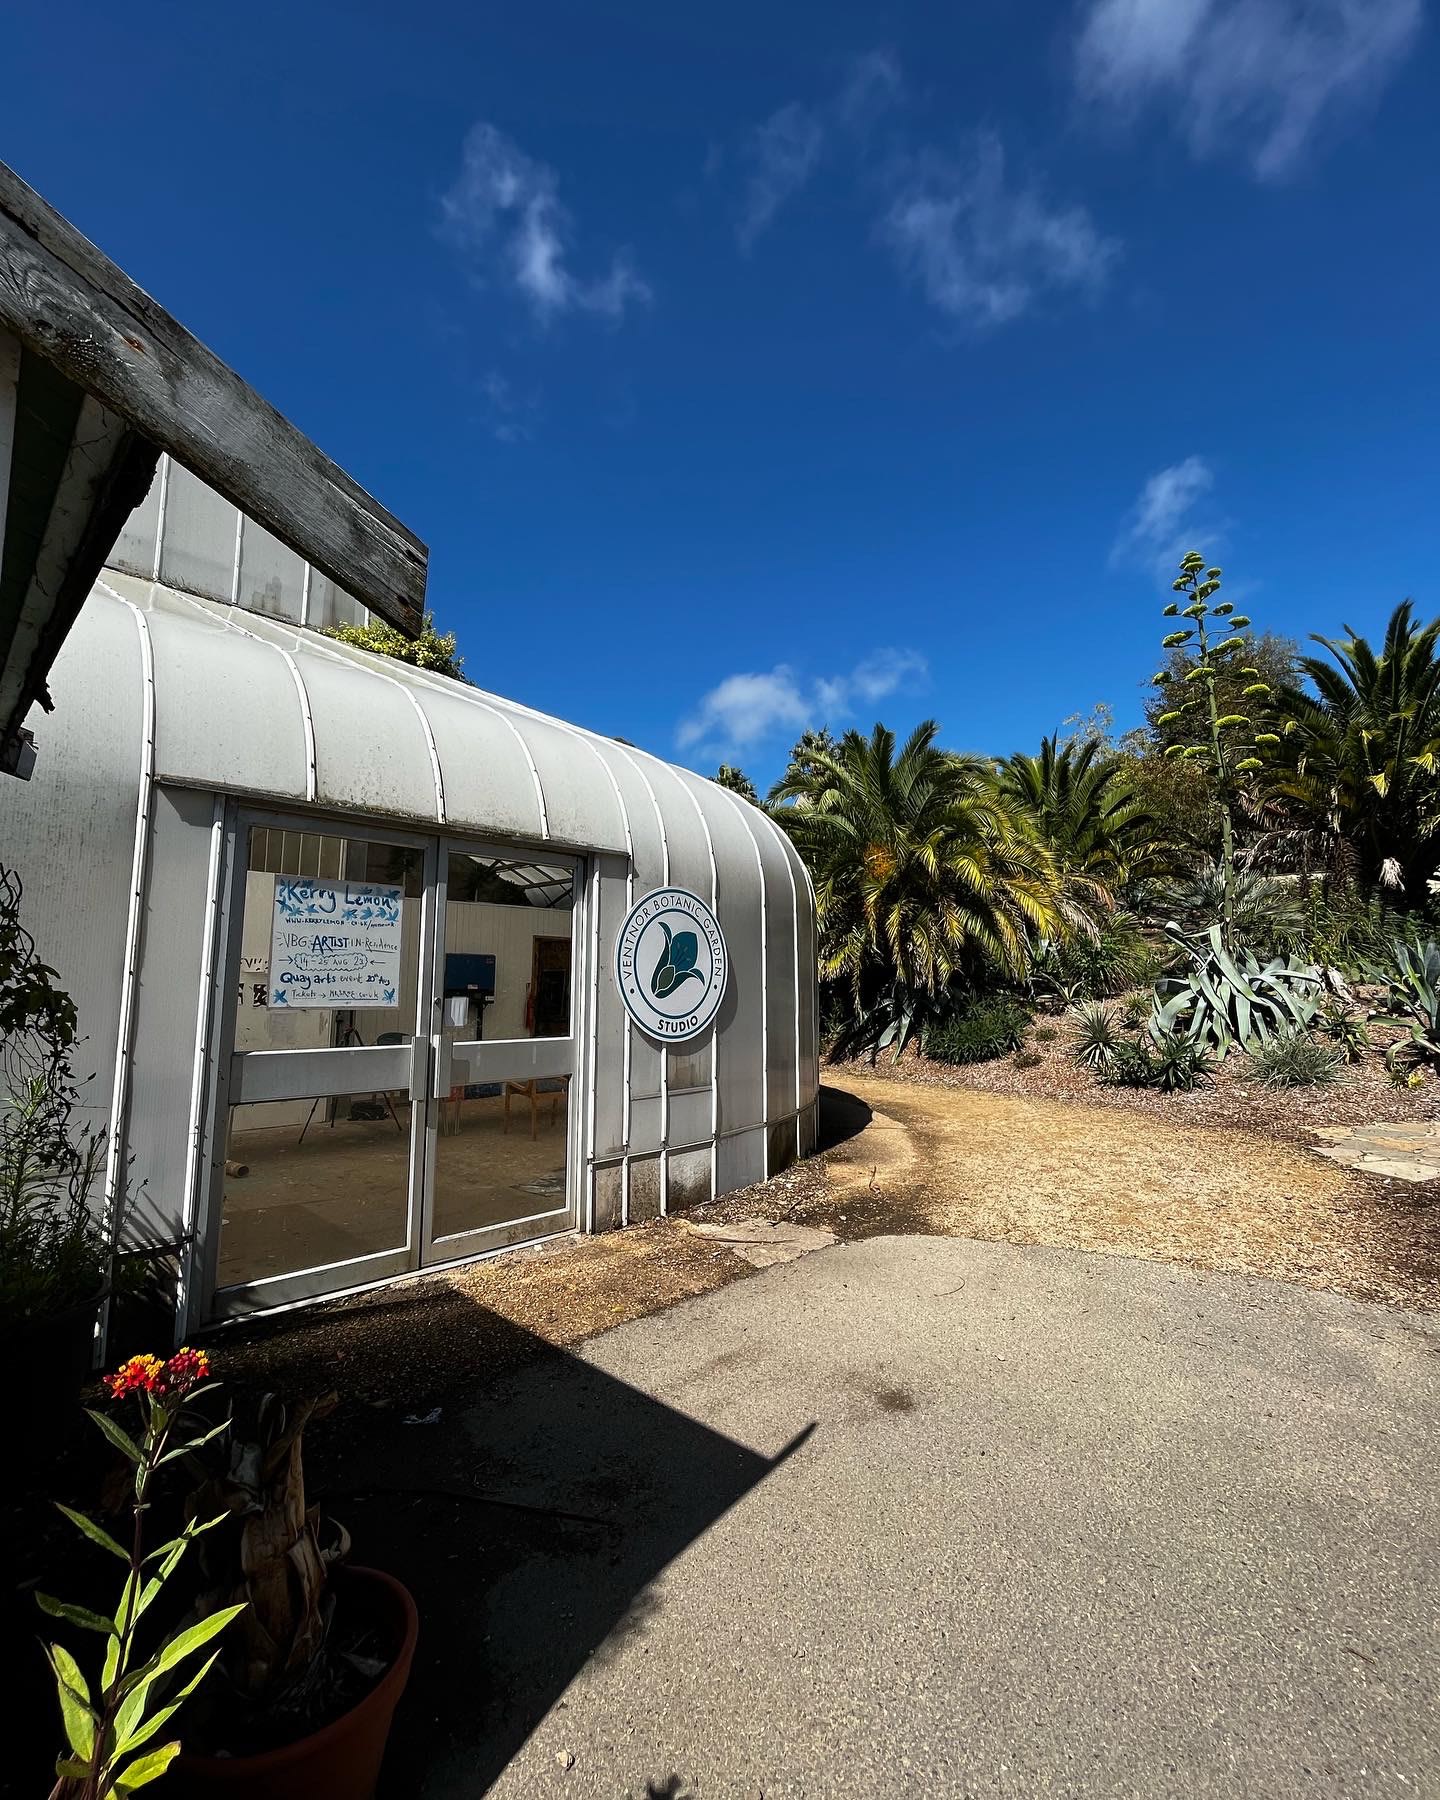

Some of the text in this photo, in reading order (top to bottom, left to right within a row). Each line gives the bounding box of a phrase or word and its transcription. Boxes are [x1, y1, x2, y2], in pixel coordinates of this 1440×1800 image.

[286, 880, 393, 913] Kerry Lemon
[282, 932, 309, 948] VBG
[622, 895, 723, 980] VENTNOR BOTANIC GARDEN
[300, 957, 308, 967] 14
[318, 958, 328, 966] 25
[354, 955, 364, 966] 23
[280, 972, 311, 990] Quay
[313, 973, 337, 984] arts
[657, 1015, 698, 1033] STUDIO
